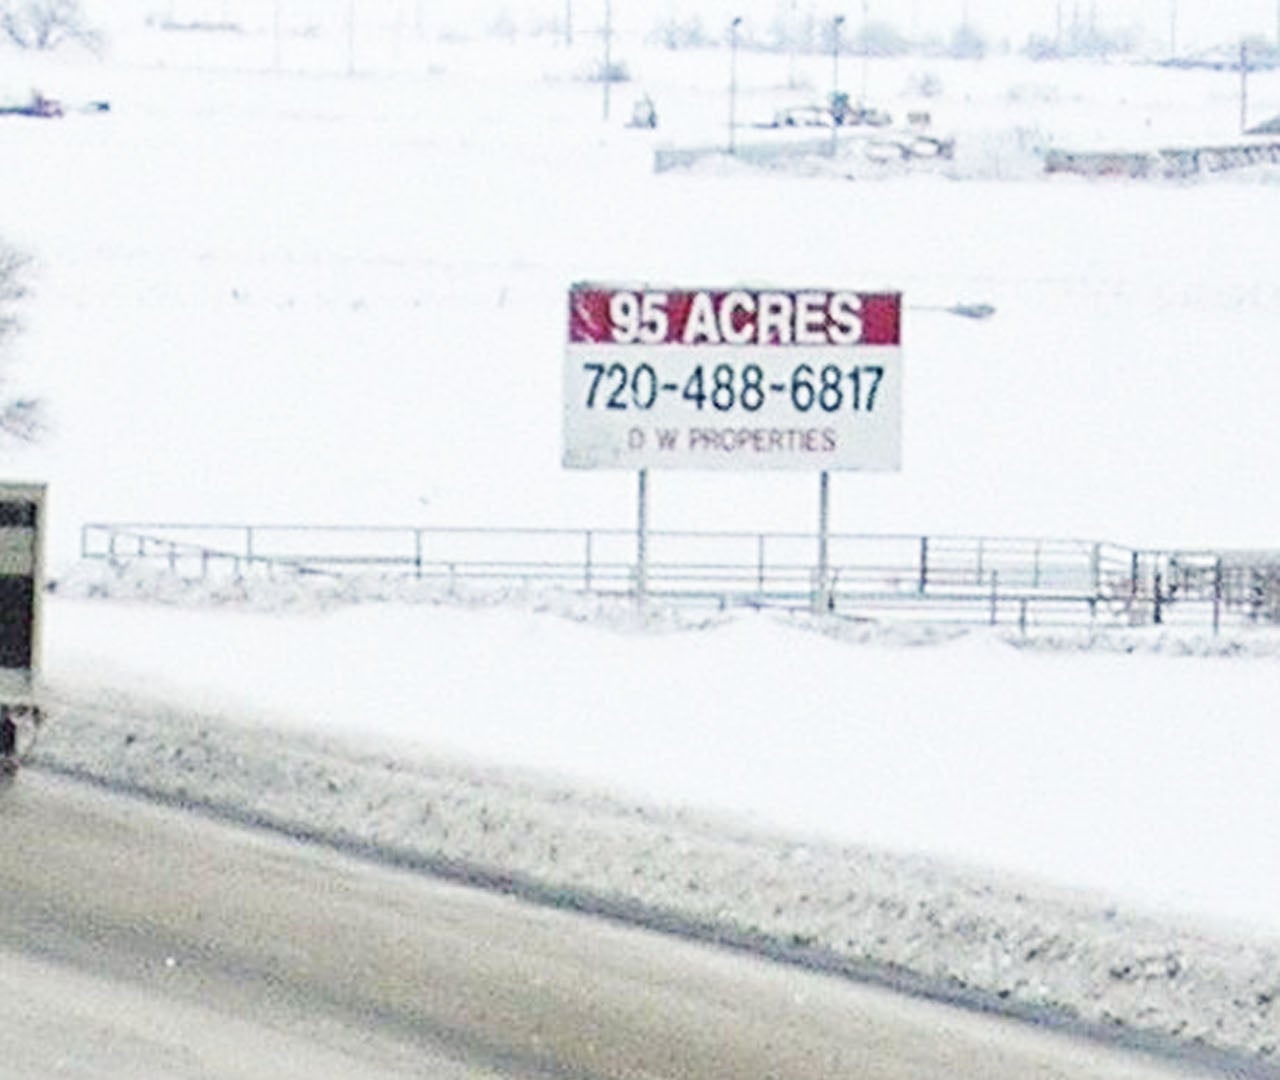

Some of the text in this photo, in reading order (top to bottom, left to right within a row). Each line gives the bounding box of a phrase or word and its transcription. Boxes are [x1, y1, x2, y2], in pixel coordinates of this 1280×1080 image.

[609, 291, 864, 345] 95 ACRES
[583, 362, 885, 412] 720-488-6817
[655, 427, 679, 451] W
[689, 427, 837, 452] PROPERTIES
